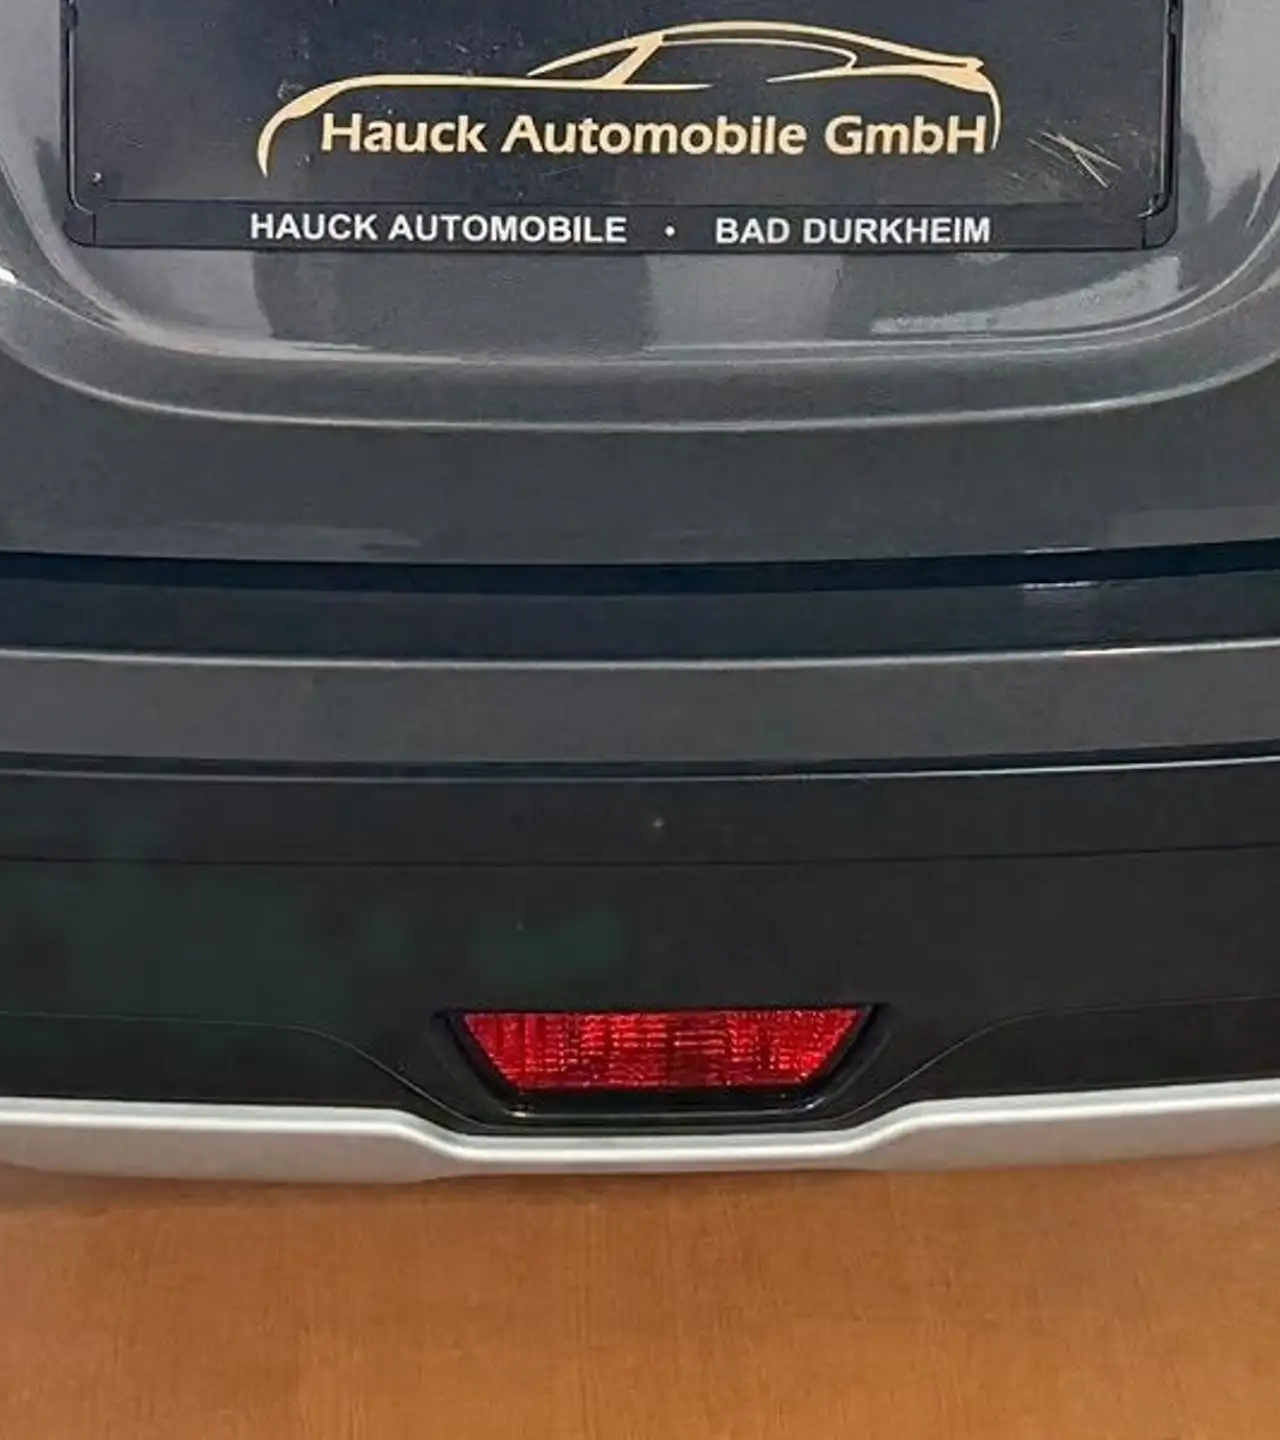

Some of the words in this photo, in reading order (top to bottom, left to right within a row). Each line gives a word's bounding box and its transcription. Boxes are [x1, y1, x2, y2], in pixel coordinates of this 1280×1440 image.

[321, 112, 488, 154] Hauck
[500, 114, 807, 156] Automobile
[824, 114, 987, 156] GmbH
[250, 212, 378, 241] HAUCK
[388, 214, 628, 244] AUTOMOBILE
[715, 216, 790, 244] BAD
[802, 216, 991, 245] DURKHEIM
